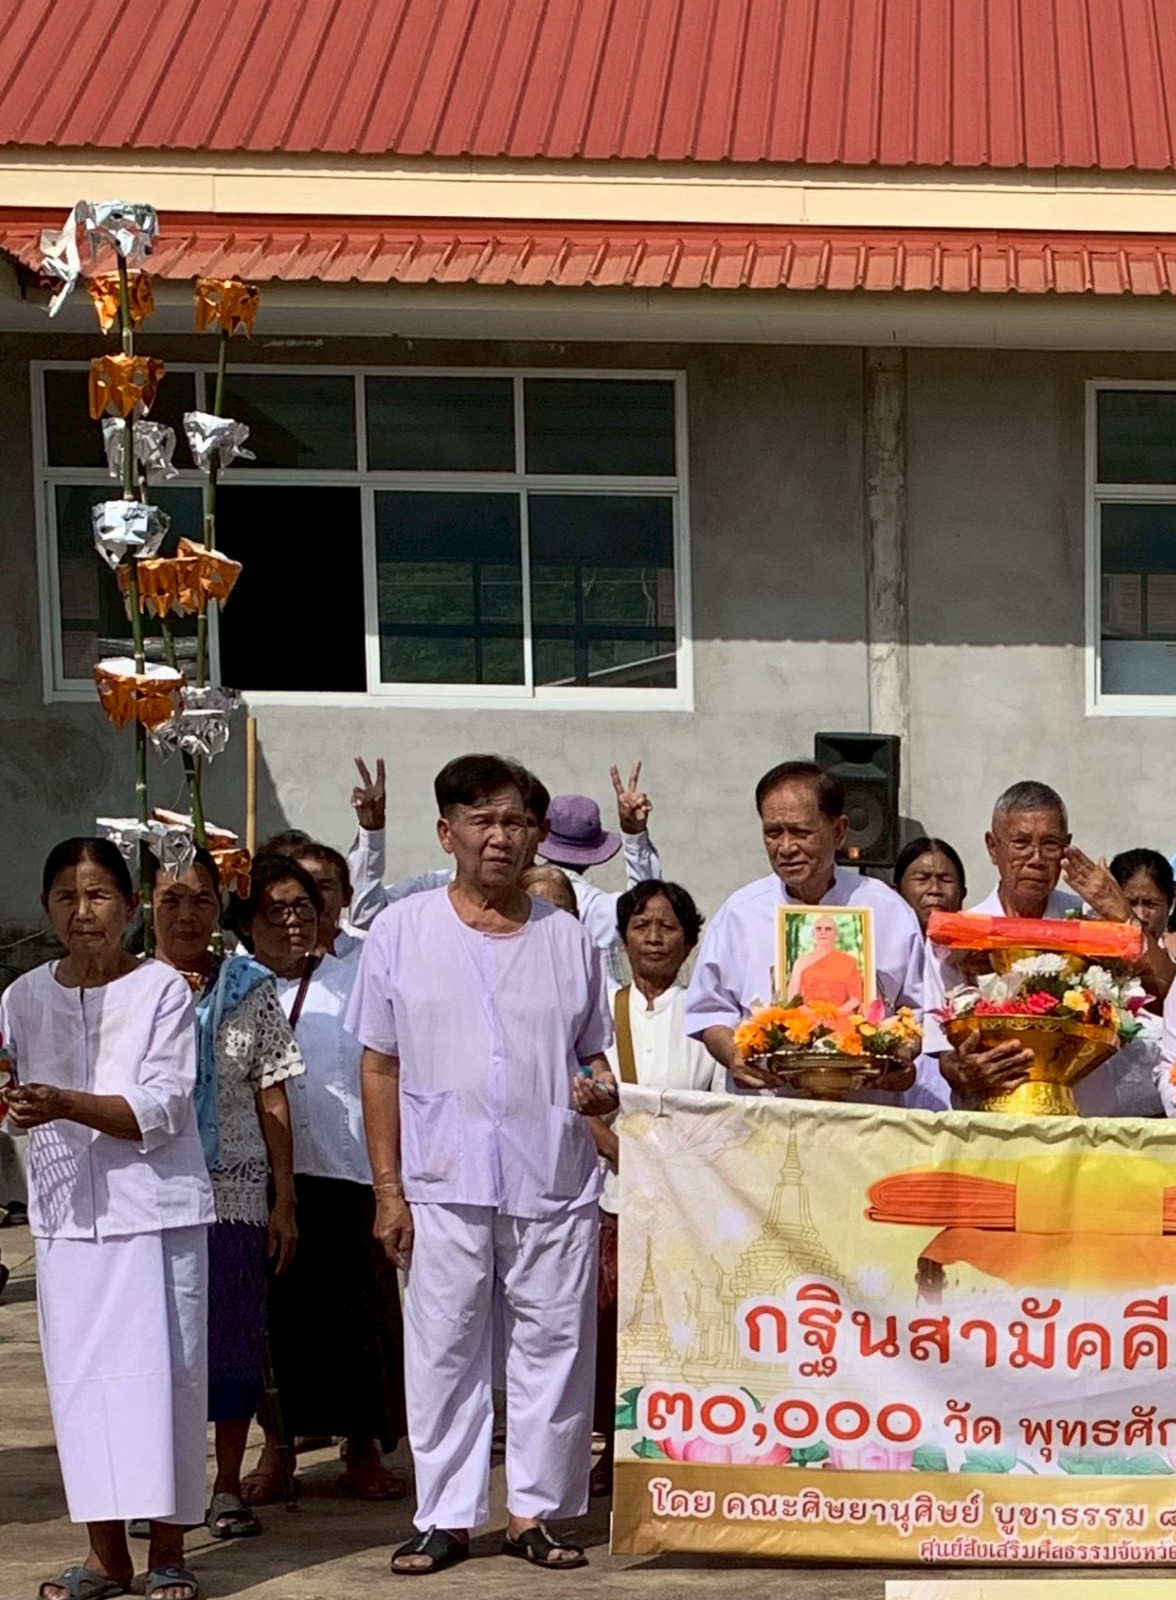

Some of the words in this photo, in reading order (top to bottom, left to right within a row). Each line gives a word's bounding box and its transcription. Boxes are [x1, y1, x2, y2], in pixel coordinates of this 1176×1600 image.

[647, 1391, 922, 1446] ๓๐,๐๐๐
[944, 1399, 1001, 1445] วัด
[653, 1482, 711, 1514] โดย
[726, 1491, 981, 1532] คณะศิษยานุศิษย์
[995, 1506, 1145, 1534] บูชาธรรม
